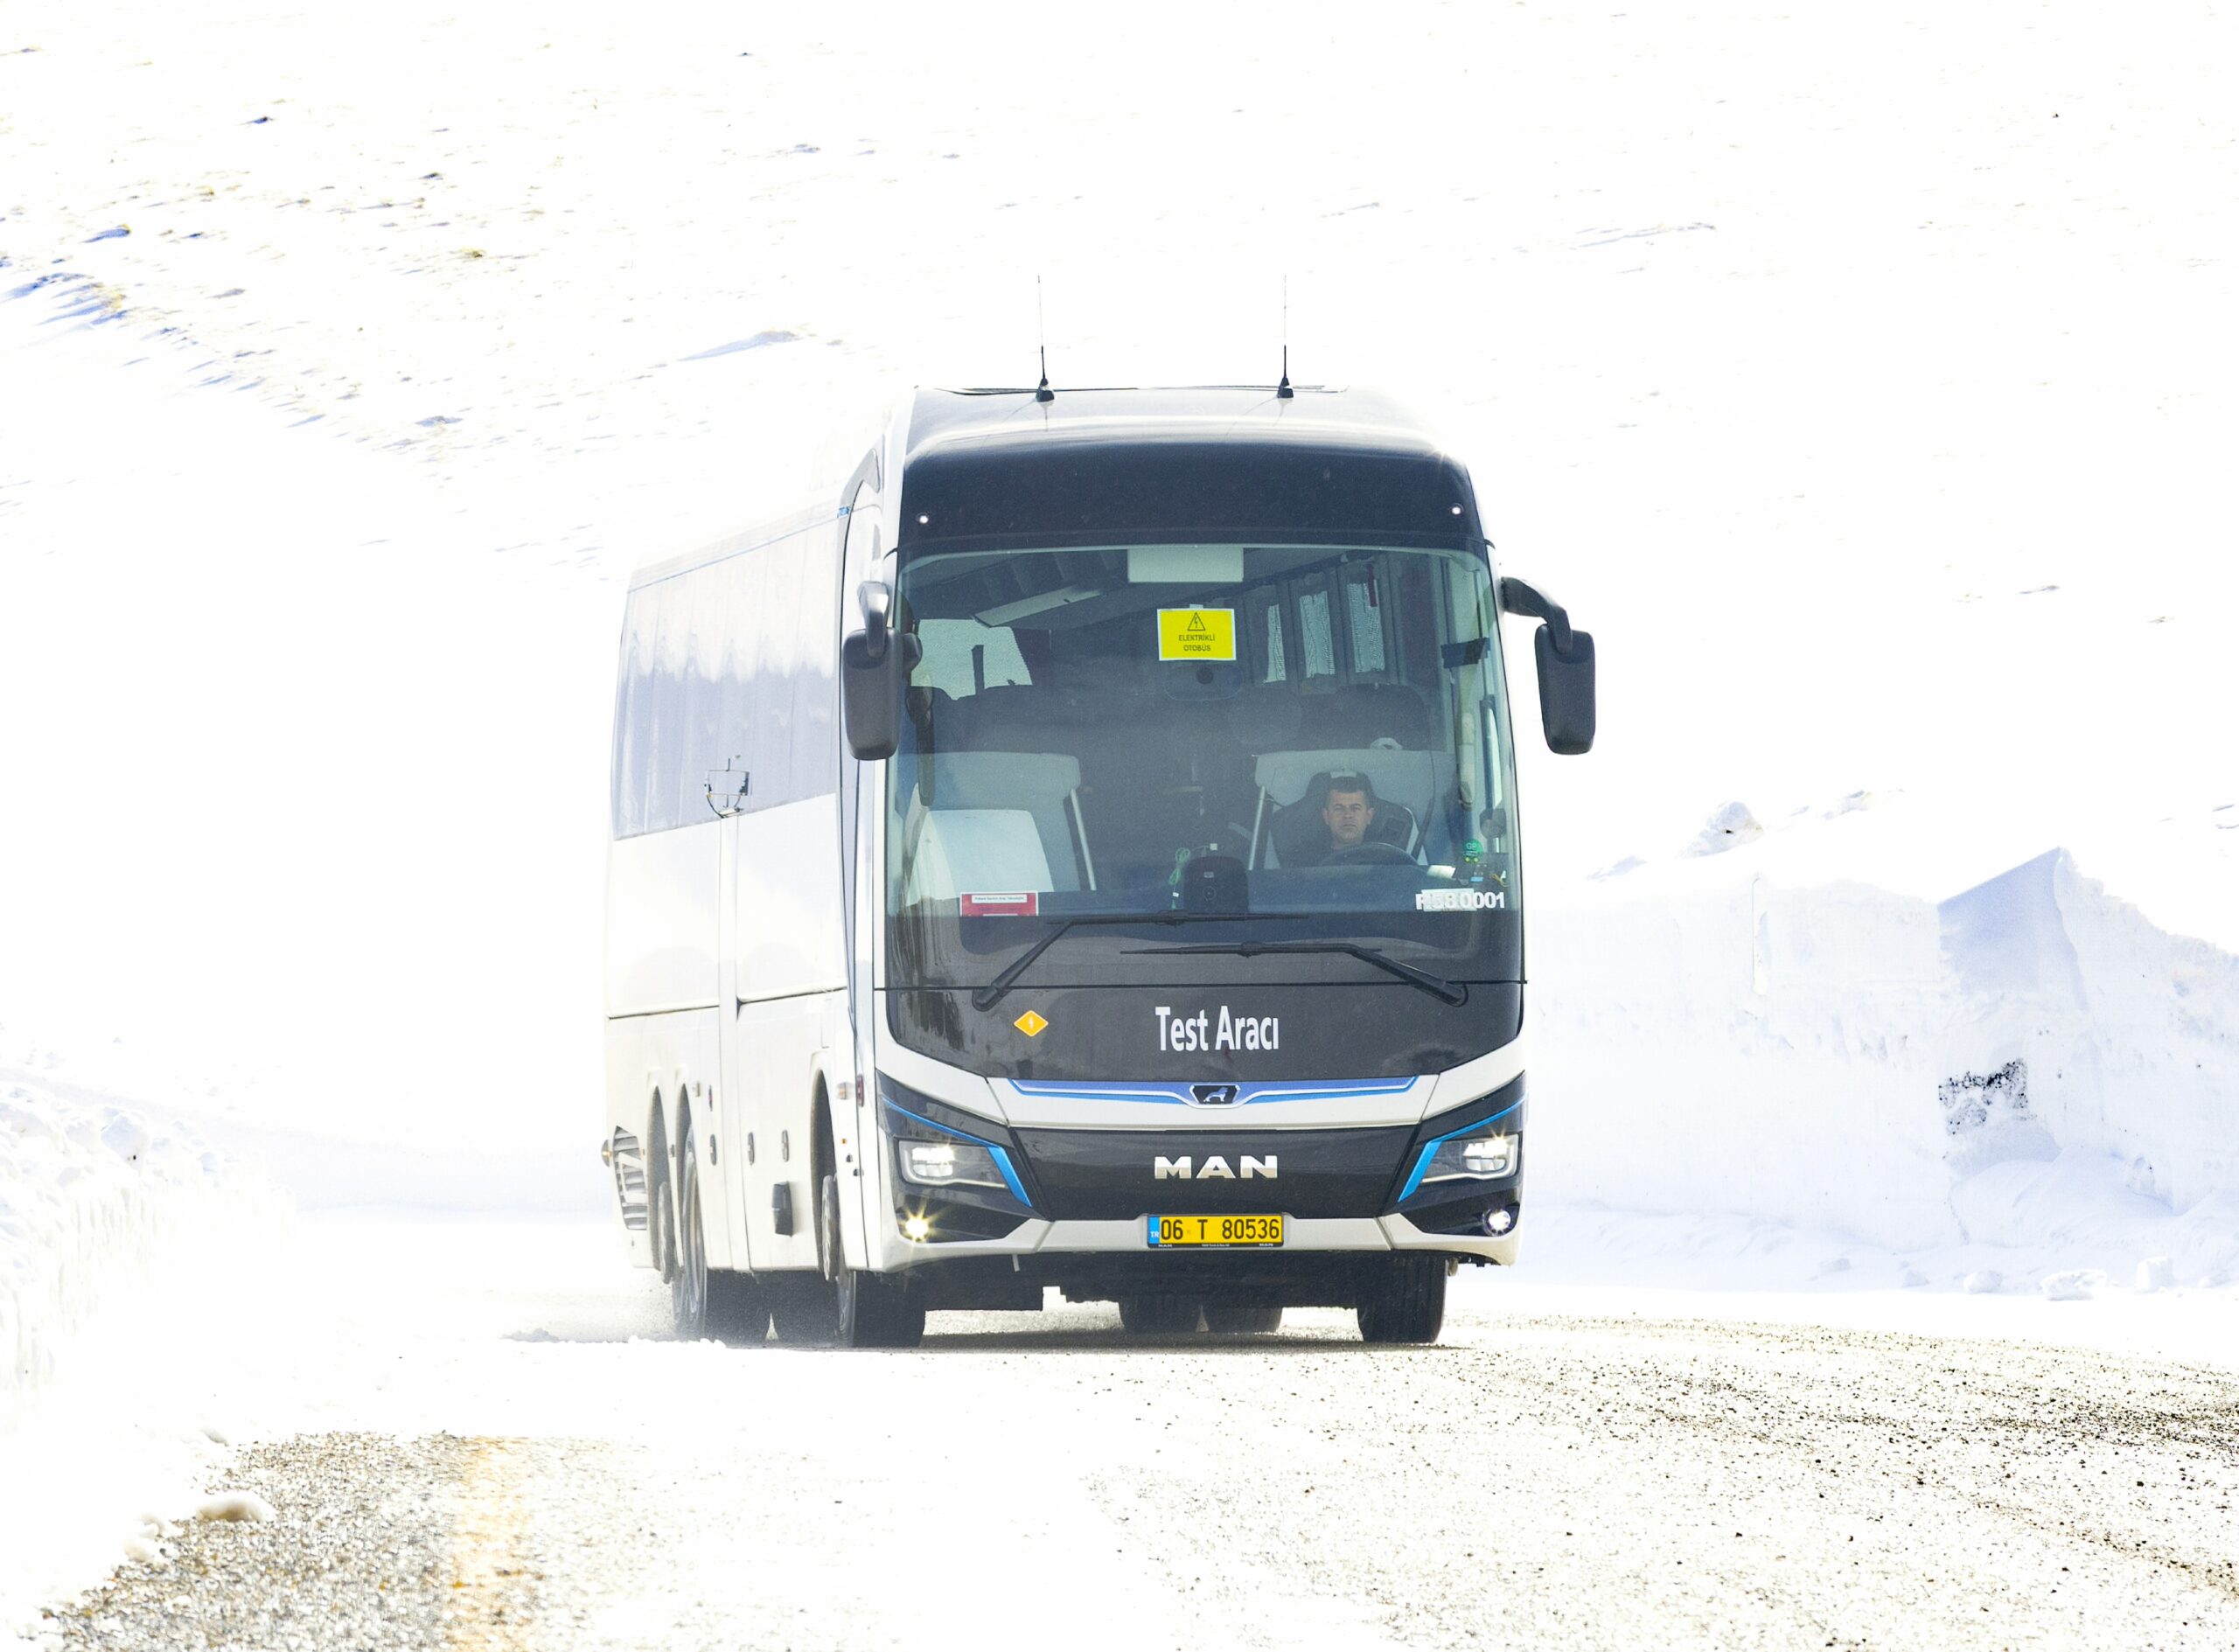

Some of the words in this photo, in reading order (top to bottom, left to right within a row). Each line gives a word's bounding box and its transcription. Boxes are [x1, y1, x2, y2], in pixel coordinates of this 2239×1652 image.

[1178, 633, 1216, 642] ELEKTRİKLİ
[1154, 1006, 1209, 1051] Test
[1215, 1006, 1280, 1050] Aracı
[1154, 1154, 1278, 1180] MAN
[1161, 1219, 1183, 1240] 06
[1197, 1219, 1208, 1240] T
[1222, 1218, 1280, 1239] 80536
